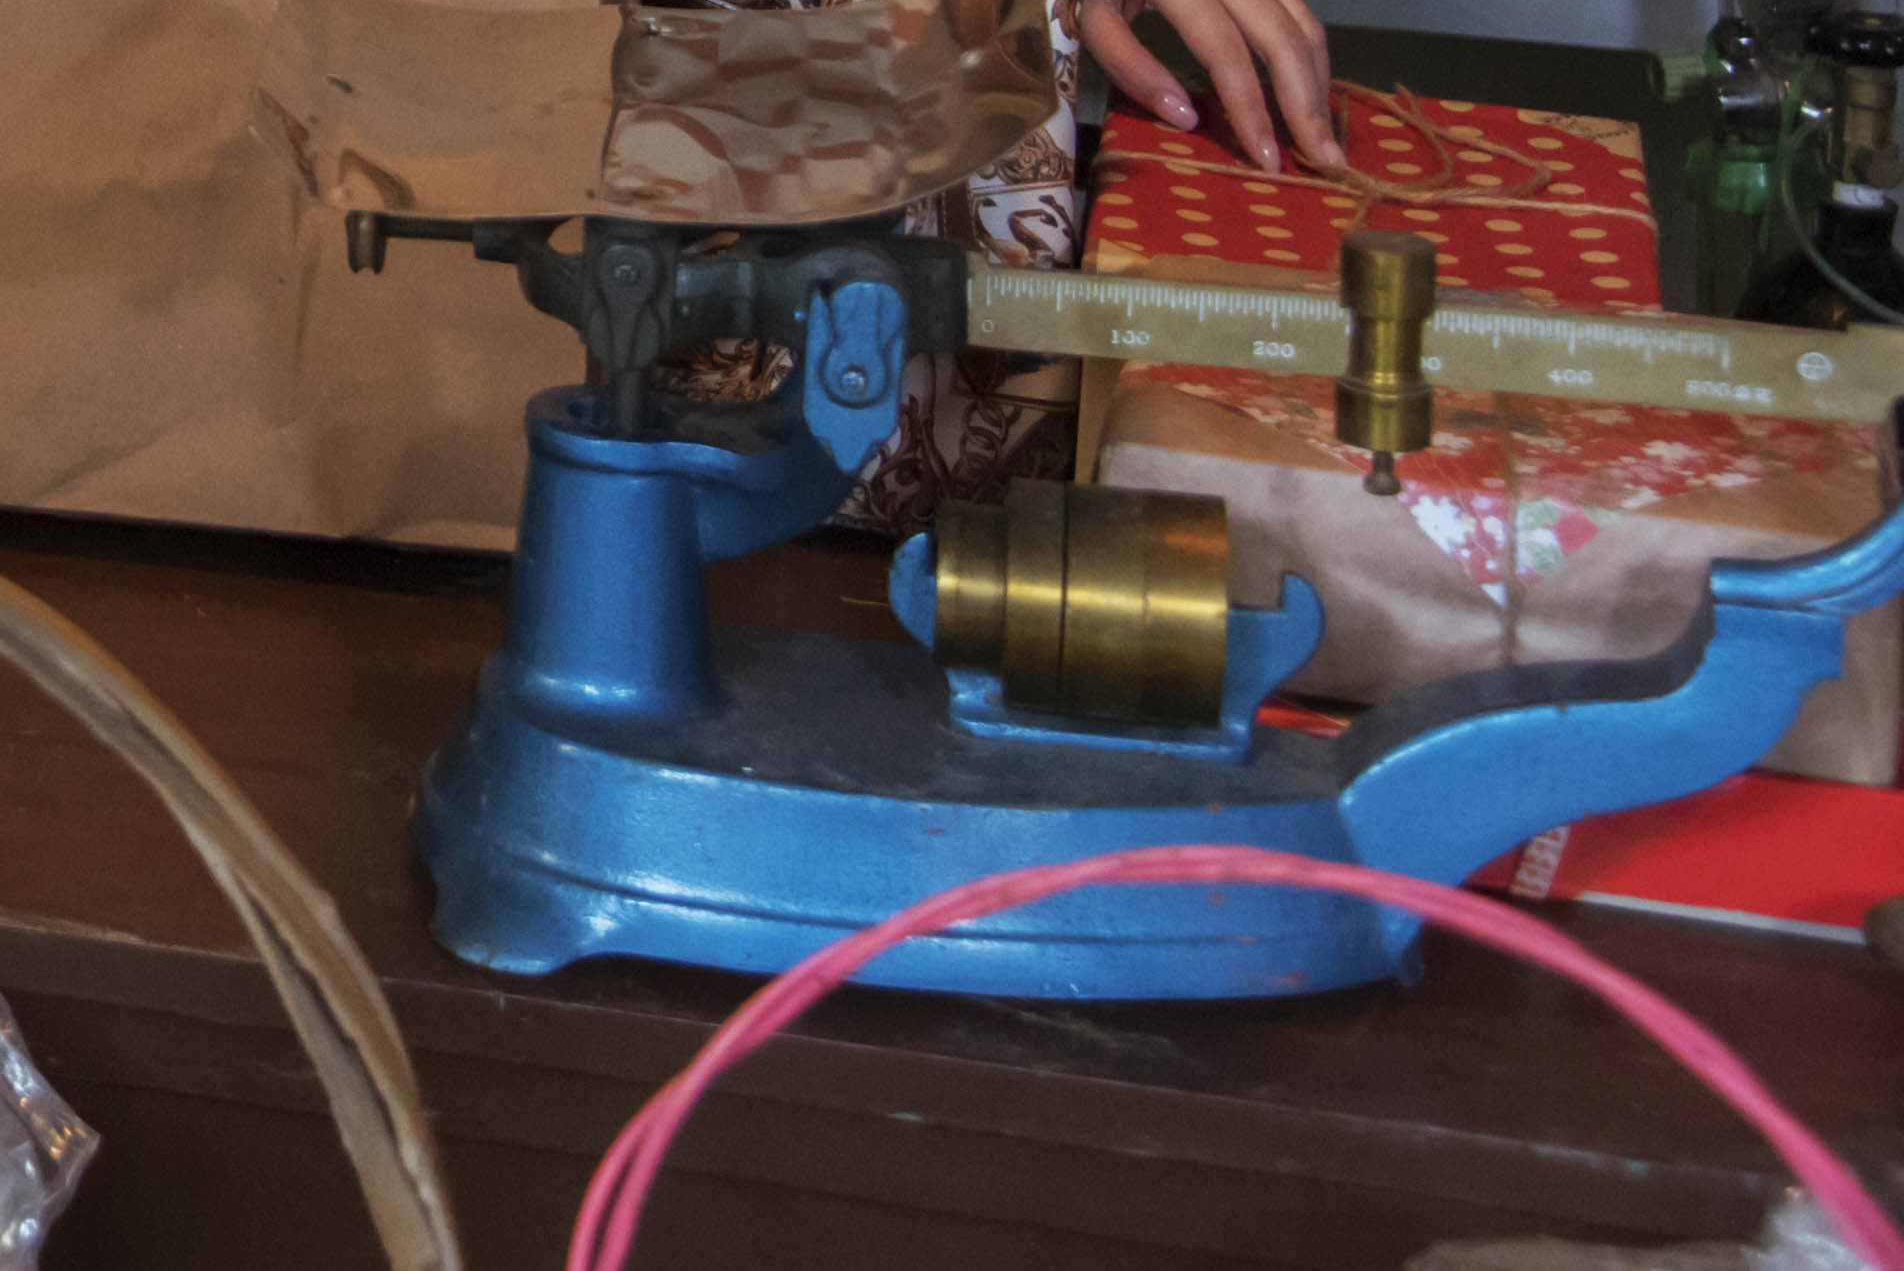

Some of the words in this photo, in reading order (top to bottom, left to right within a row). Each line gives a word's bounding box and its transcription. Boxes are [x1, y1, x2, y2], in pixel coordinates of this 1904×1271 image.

[1110, 328, 1150, 347] 100
[1252, 339, 1297, 359] 200
[1546, 368, 1594, 387] 400
